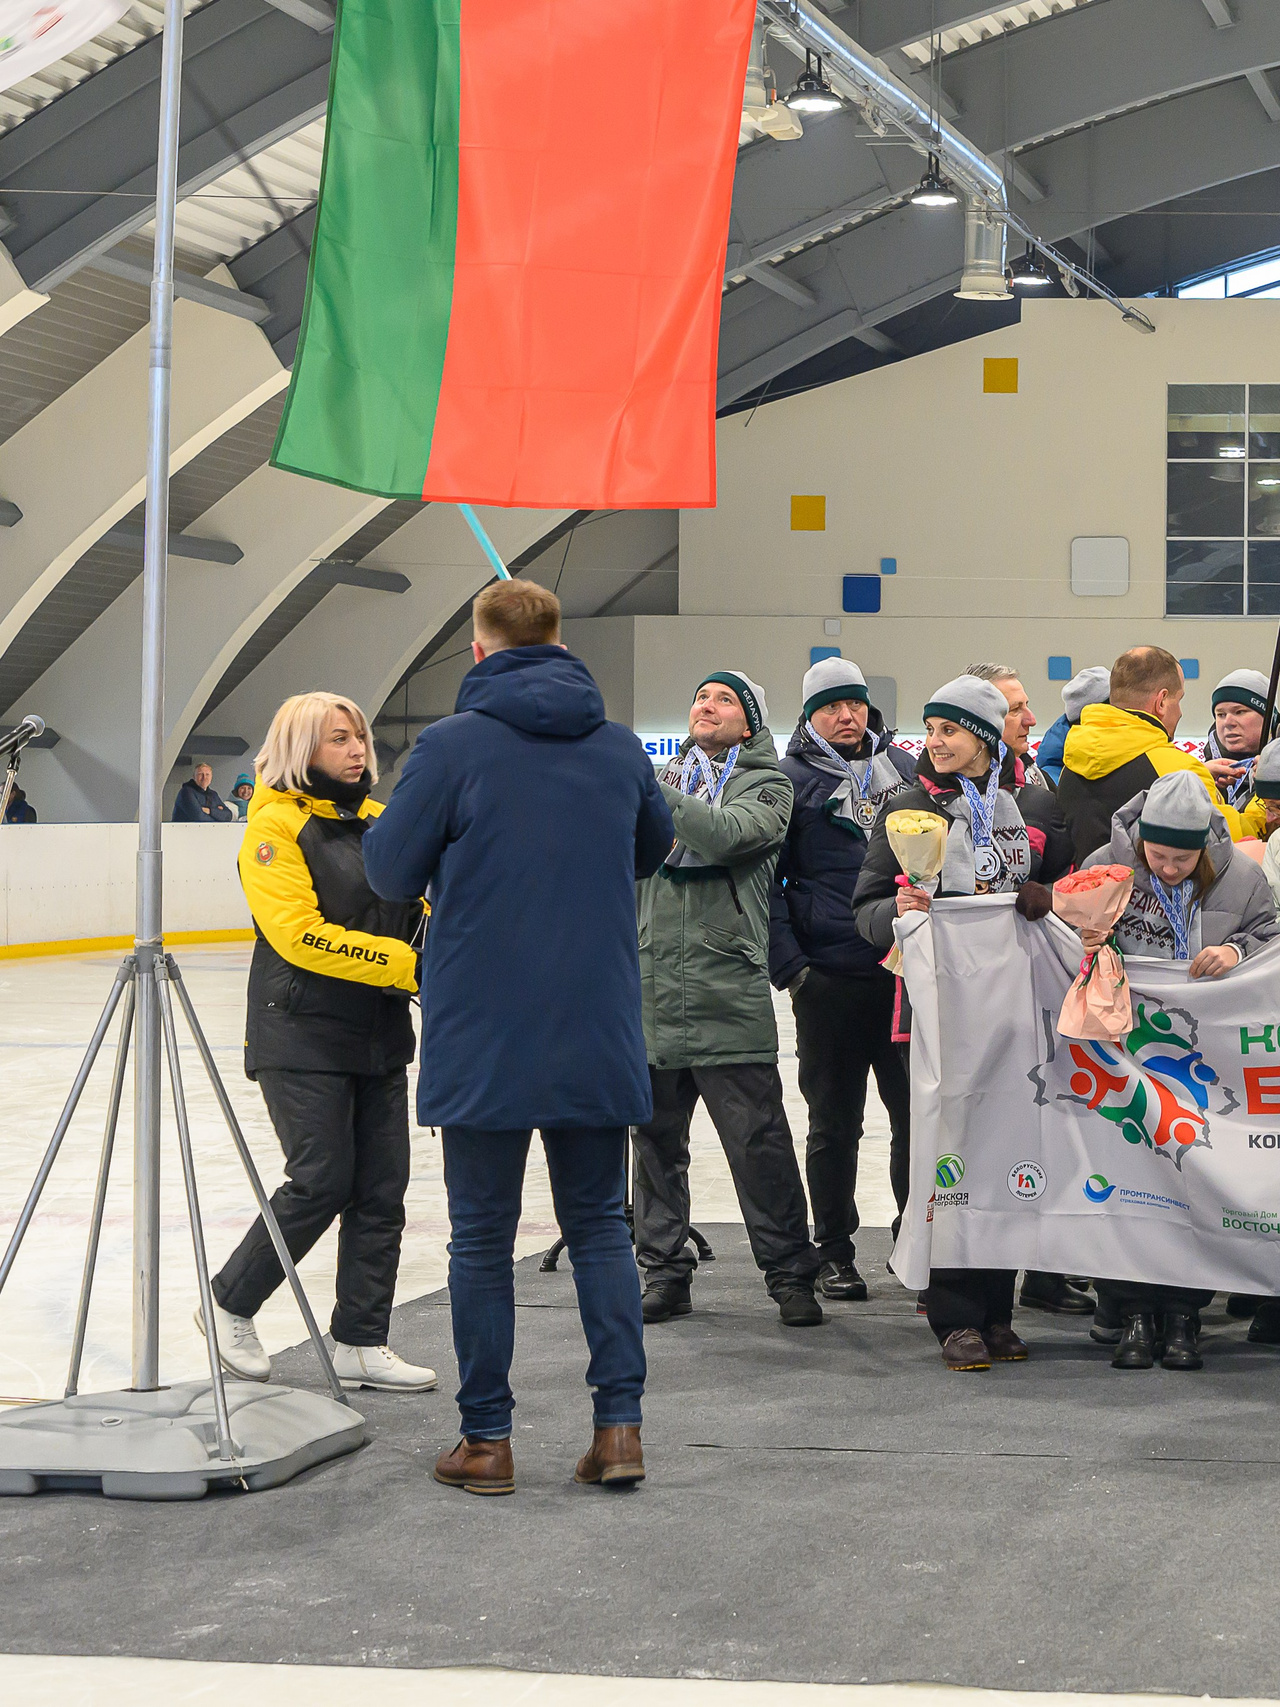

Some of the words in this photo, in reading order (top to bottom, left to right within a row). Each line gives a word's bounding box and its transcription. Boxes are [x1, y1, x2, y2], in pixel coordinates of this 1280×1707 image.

[301, 932, 389, 966] BELARUS
[1120, 1188, 1191, 1211] ПРОМТРАНСИНВЕСТ
[1260, 1210, 1278, 1219] Дом
